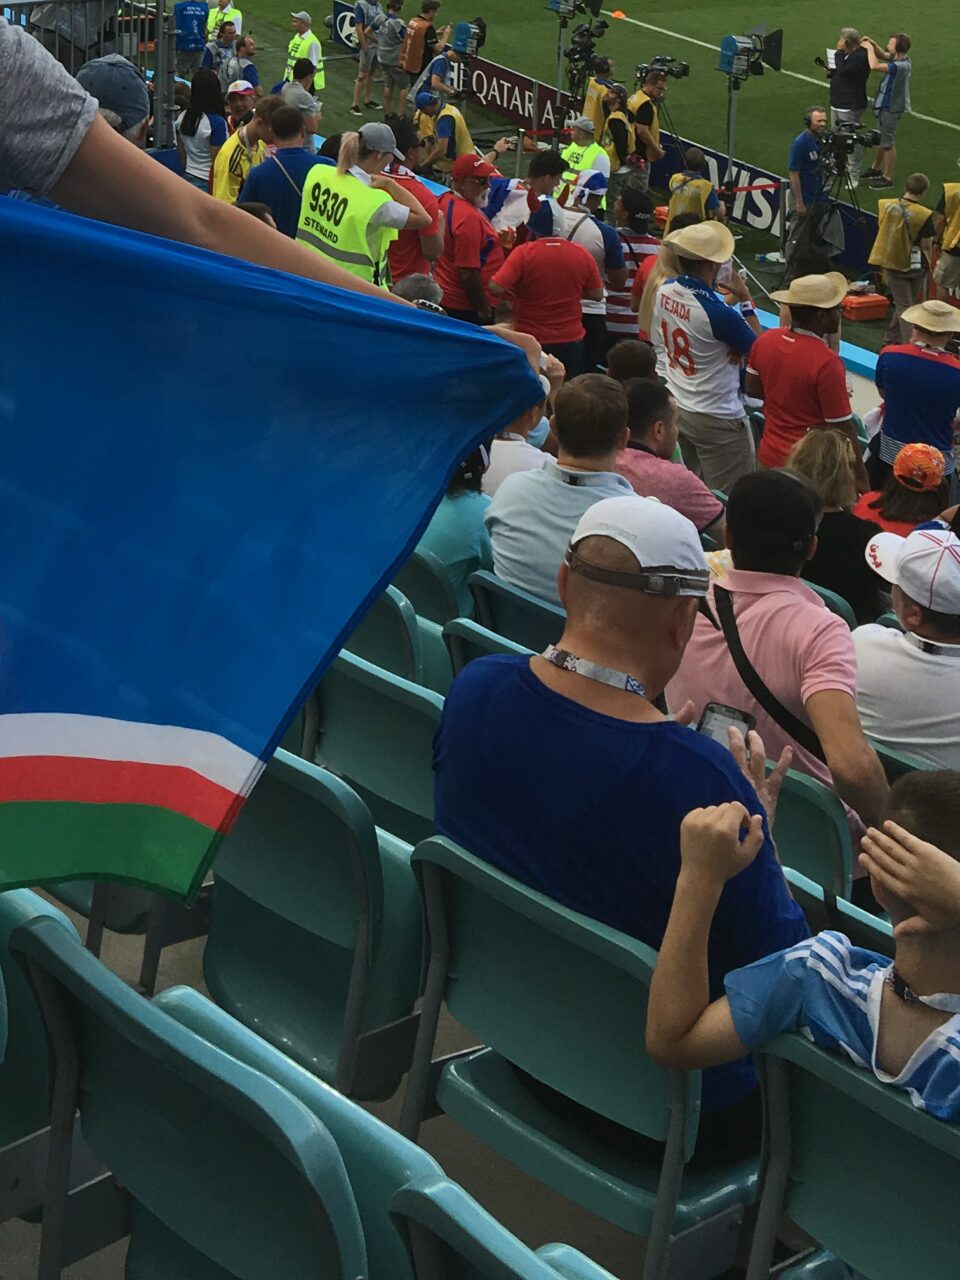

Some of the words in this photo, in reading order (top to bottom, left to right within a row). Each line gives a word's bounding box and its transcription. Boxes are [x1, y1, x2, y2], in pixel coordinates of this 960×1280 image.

[472, 70, 534, 119] QATAR
[309, 182, 349, 227] 9330
[704, 154, 791, 238] VIS
[303, 216, 339, 244] STEWARD
[660, 293, 691, 323] TEJADA
[661, 318, 697, 377] 18
